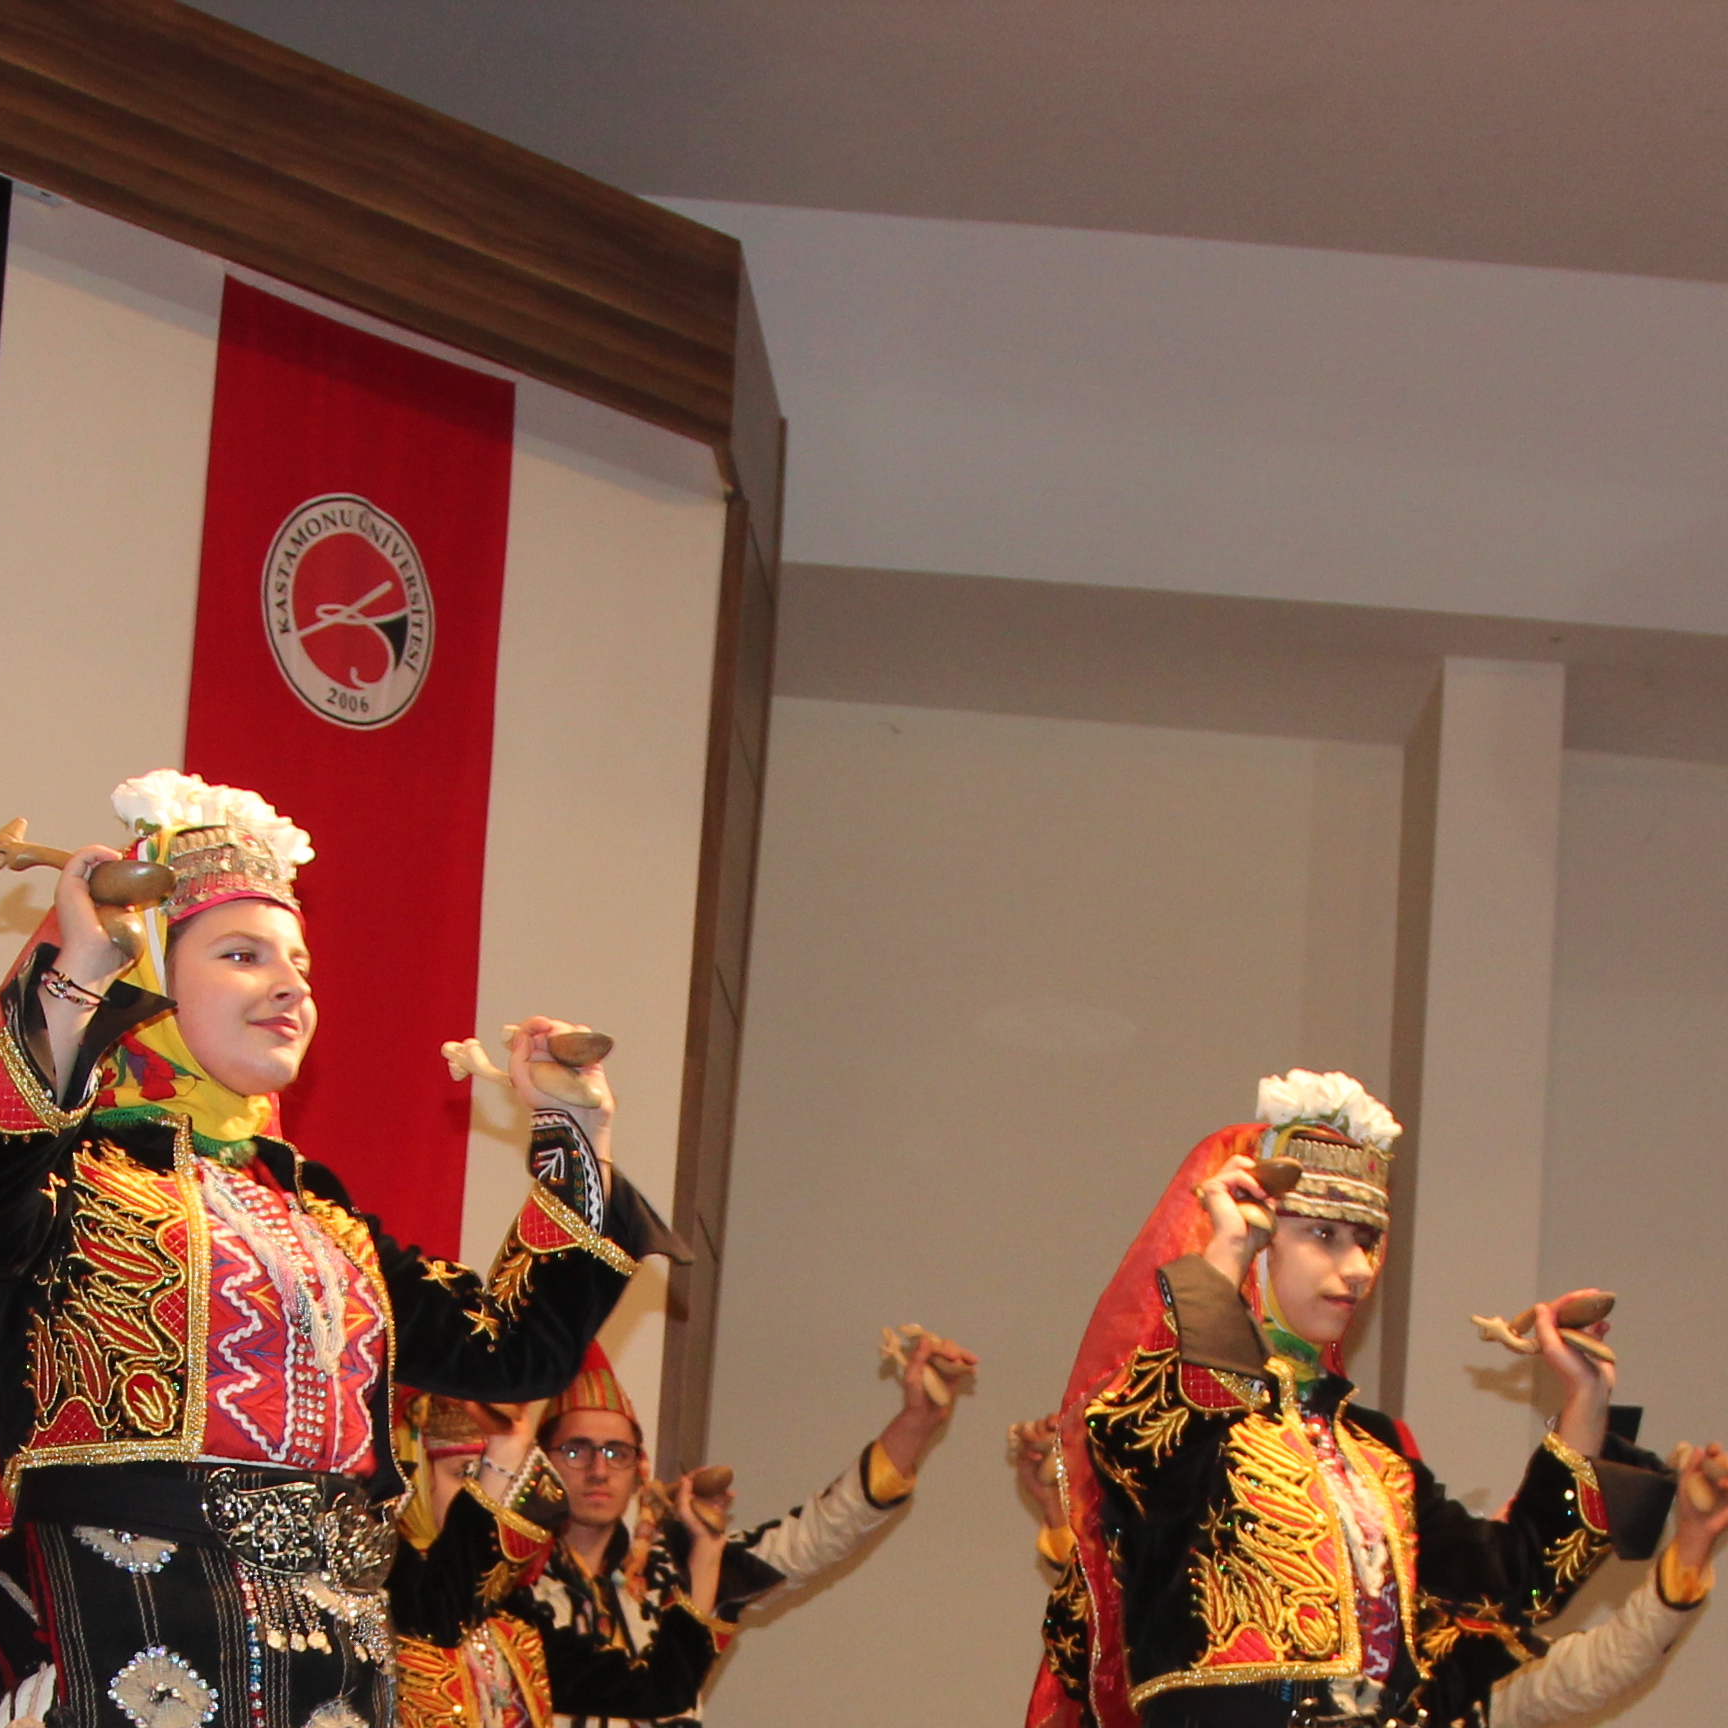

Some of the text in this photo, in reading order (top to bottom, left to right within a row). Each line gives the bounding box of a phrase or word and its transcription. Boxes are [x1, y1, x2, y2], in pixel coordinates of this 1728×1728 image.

[272, 508, 427, 673] KASTAMONU ÜNİVERSİTESİ
[325, 687, 370, 713] 2006
